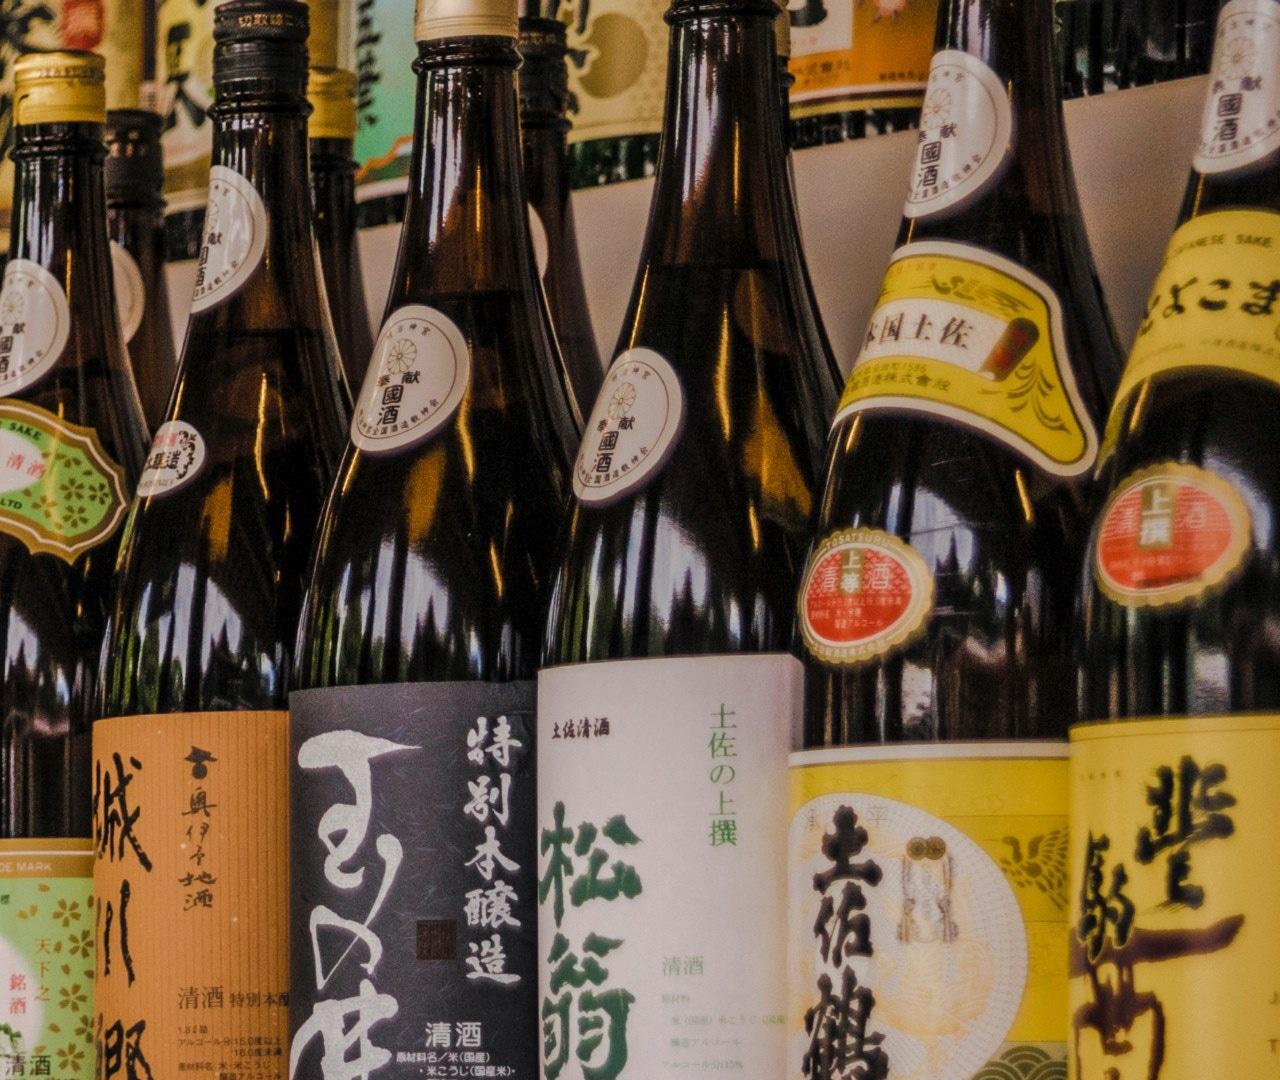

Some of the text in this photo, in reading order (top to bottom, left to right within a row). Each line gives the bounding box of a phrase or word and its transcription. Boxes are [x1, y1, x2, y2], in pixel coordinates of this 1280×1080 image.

[376, 384, 404, 426] 國酒
[591, 431, 620, 474] 國酒
[552, 716, 611, 741] 土佐清酒
[707, 702, 739, 849] 土佐の上撰
[16, 861, 53, 872] MARK
[178, 786, 218, 911] 奥伊予地酒
[462, 715, 523, 985] 特別本醸造
[9, 972, 27, 1015] 銘酒
[178, 985, 224, 1010] 清酒
[425, 1021, 483, 1048] 清酒
[4, 1054, 52, 1077] 清酒
